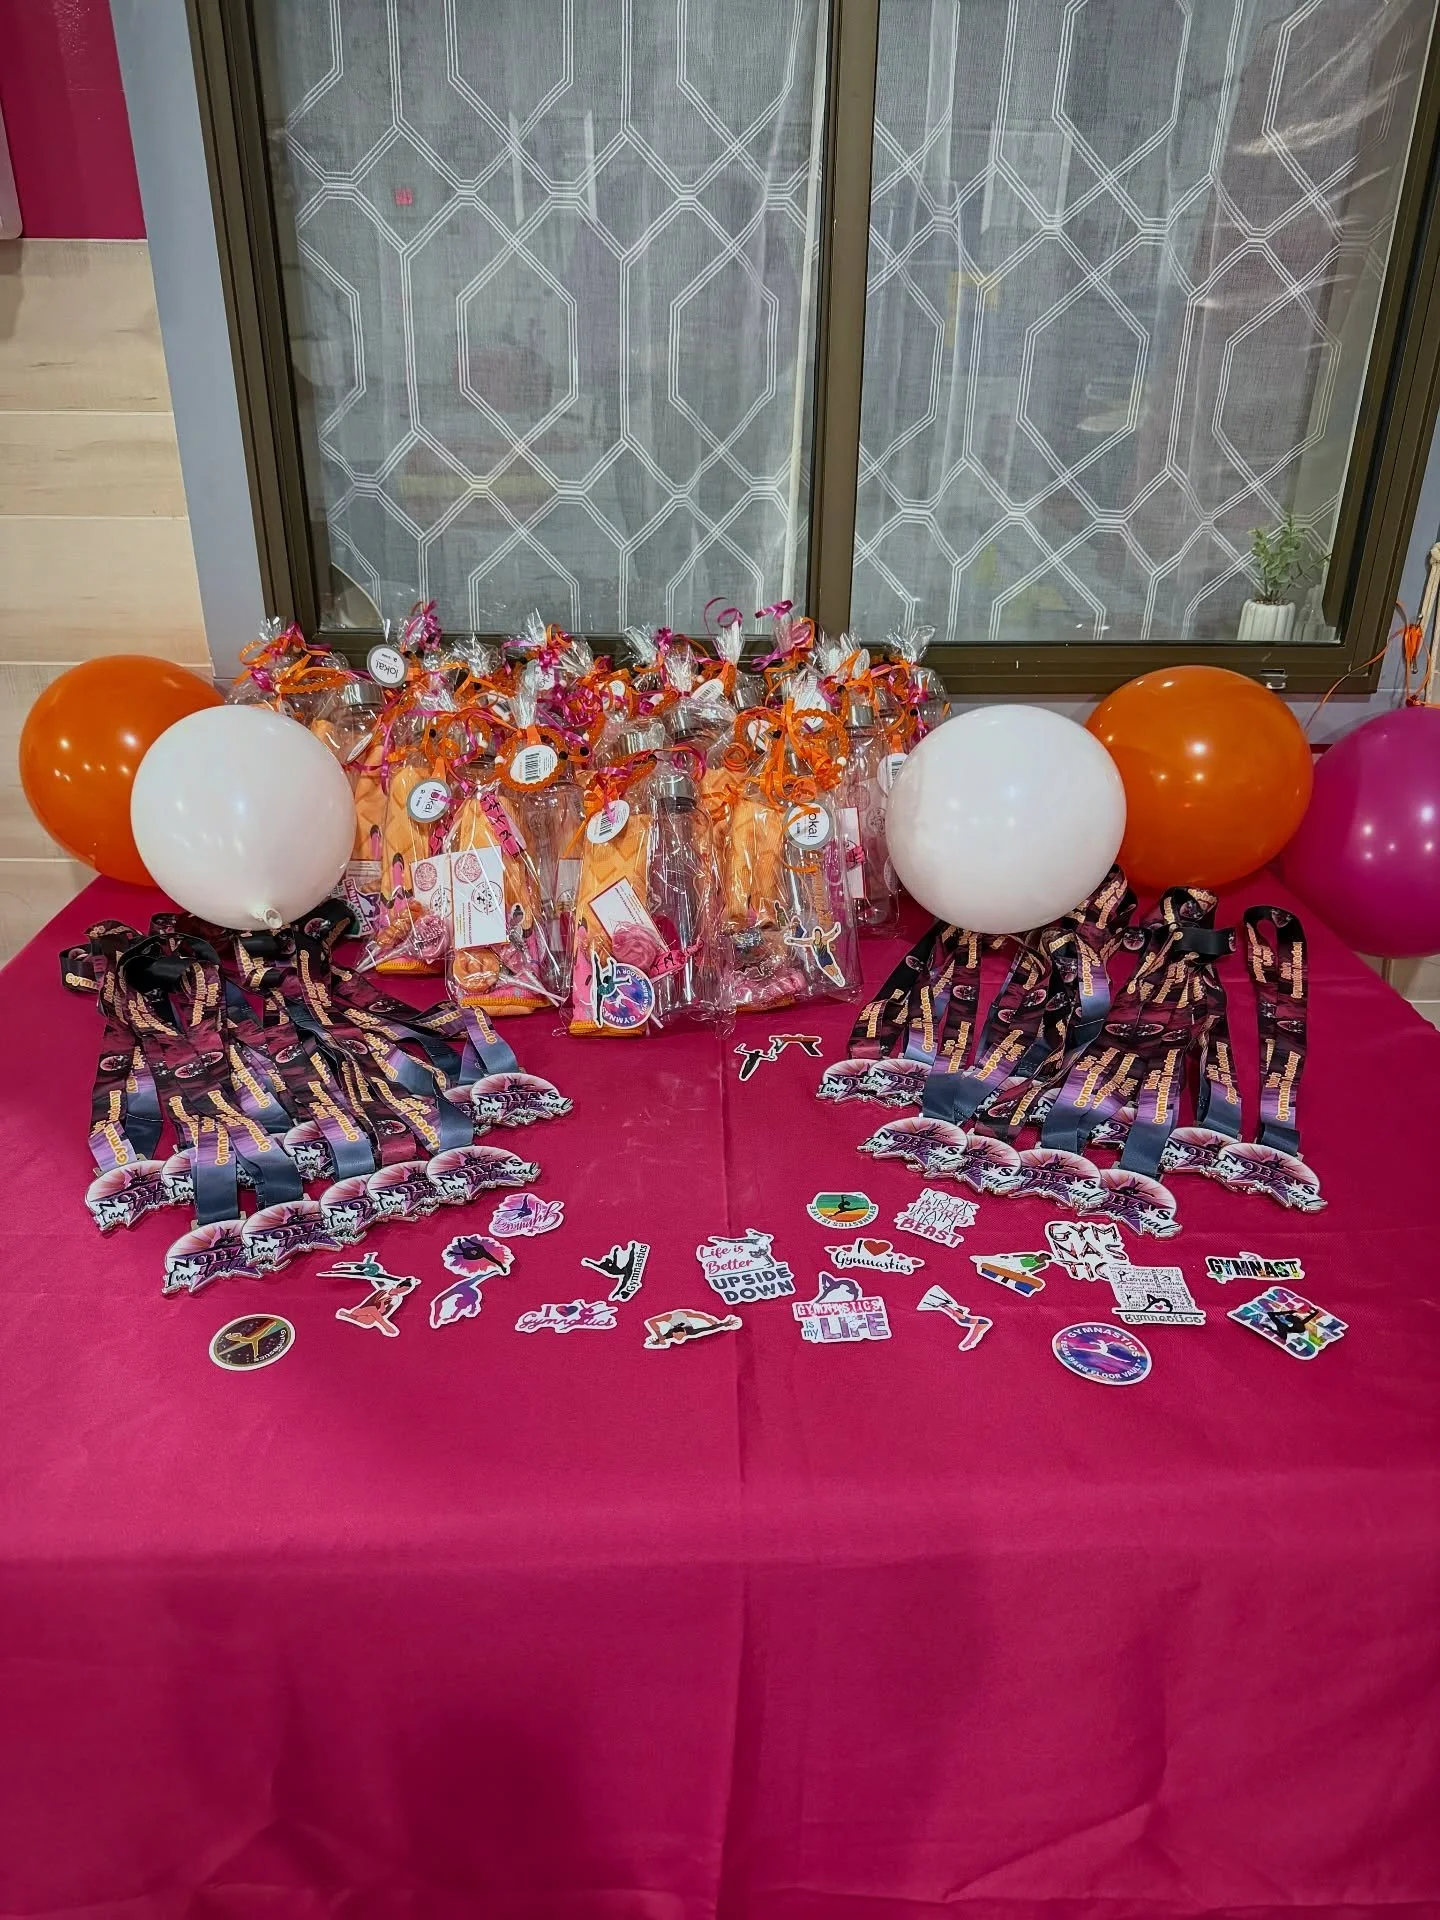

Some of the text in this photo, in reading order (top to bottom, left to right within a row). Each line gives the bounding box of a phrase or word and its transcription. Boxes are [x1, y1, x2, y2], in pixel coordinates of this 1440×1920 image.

[899, 1217, 961, 1245] BEAST
[1048, 1222, 1119, 1243] GYM
[699, 1243, 744, 1259] Life is
[857, 1240, 863, 1254] I
[626, 1244, 648, 1293] Gymnastics
[706, 1258, 754, 1275] Better
[834, 1251, 912, 1273] Gymnastics
[1059, 1259, 1113, 1280] TIC
[1207, 1257, 1301, 1279] GYMNAST
[711, 1267, 793, 1291] UPSIDE
[723, 1280, 794, 1302] DOWN
[797, 1298, 883, 1318] GYMNASTICS
[518, 1312, 614, 1332] Gymnatics
[803, 1312, 889, 1341] my LIFE
[804, 1319, 815, 1330] is
[1067, 1326, 1141, 1359] GYMNASTICS
[1090, 1369, 1122, 1380] FLOOR
